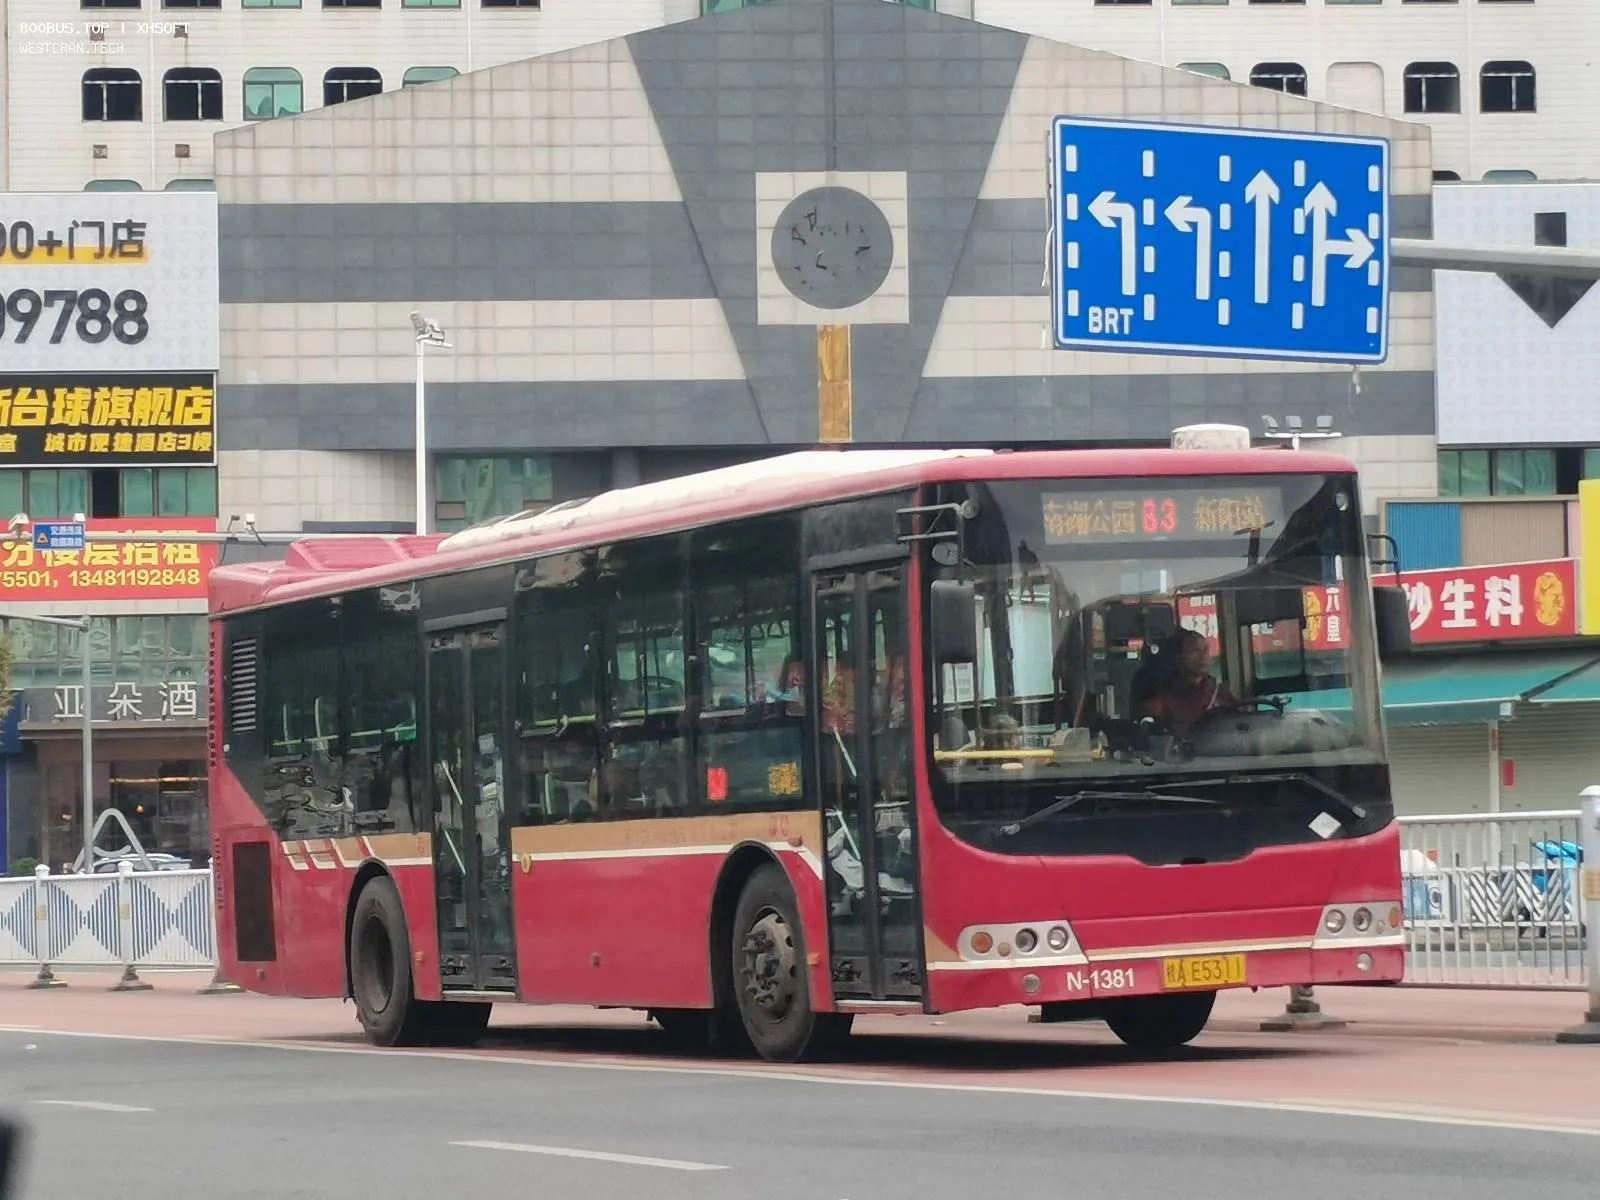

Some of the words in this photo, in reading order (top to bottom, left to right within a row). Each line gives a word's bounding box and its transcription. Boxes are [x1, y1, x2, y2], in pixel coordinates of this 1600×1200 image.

[0, 287, 149, 345] 9788
[1088, 306, 1135, 335] BRT
[0, 571, 58, 589] 5501,
[68, 568, 201, 587] 13481192848
[1066, 968, 1135, 992] N-1381
